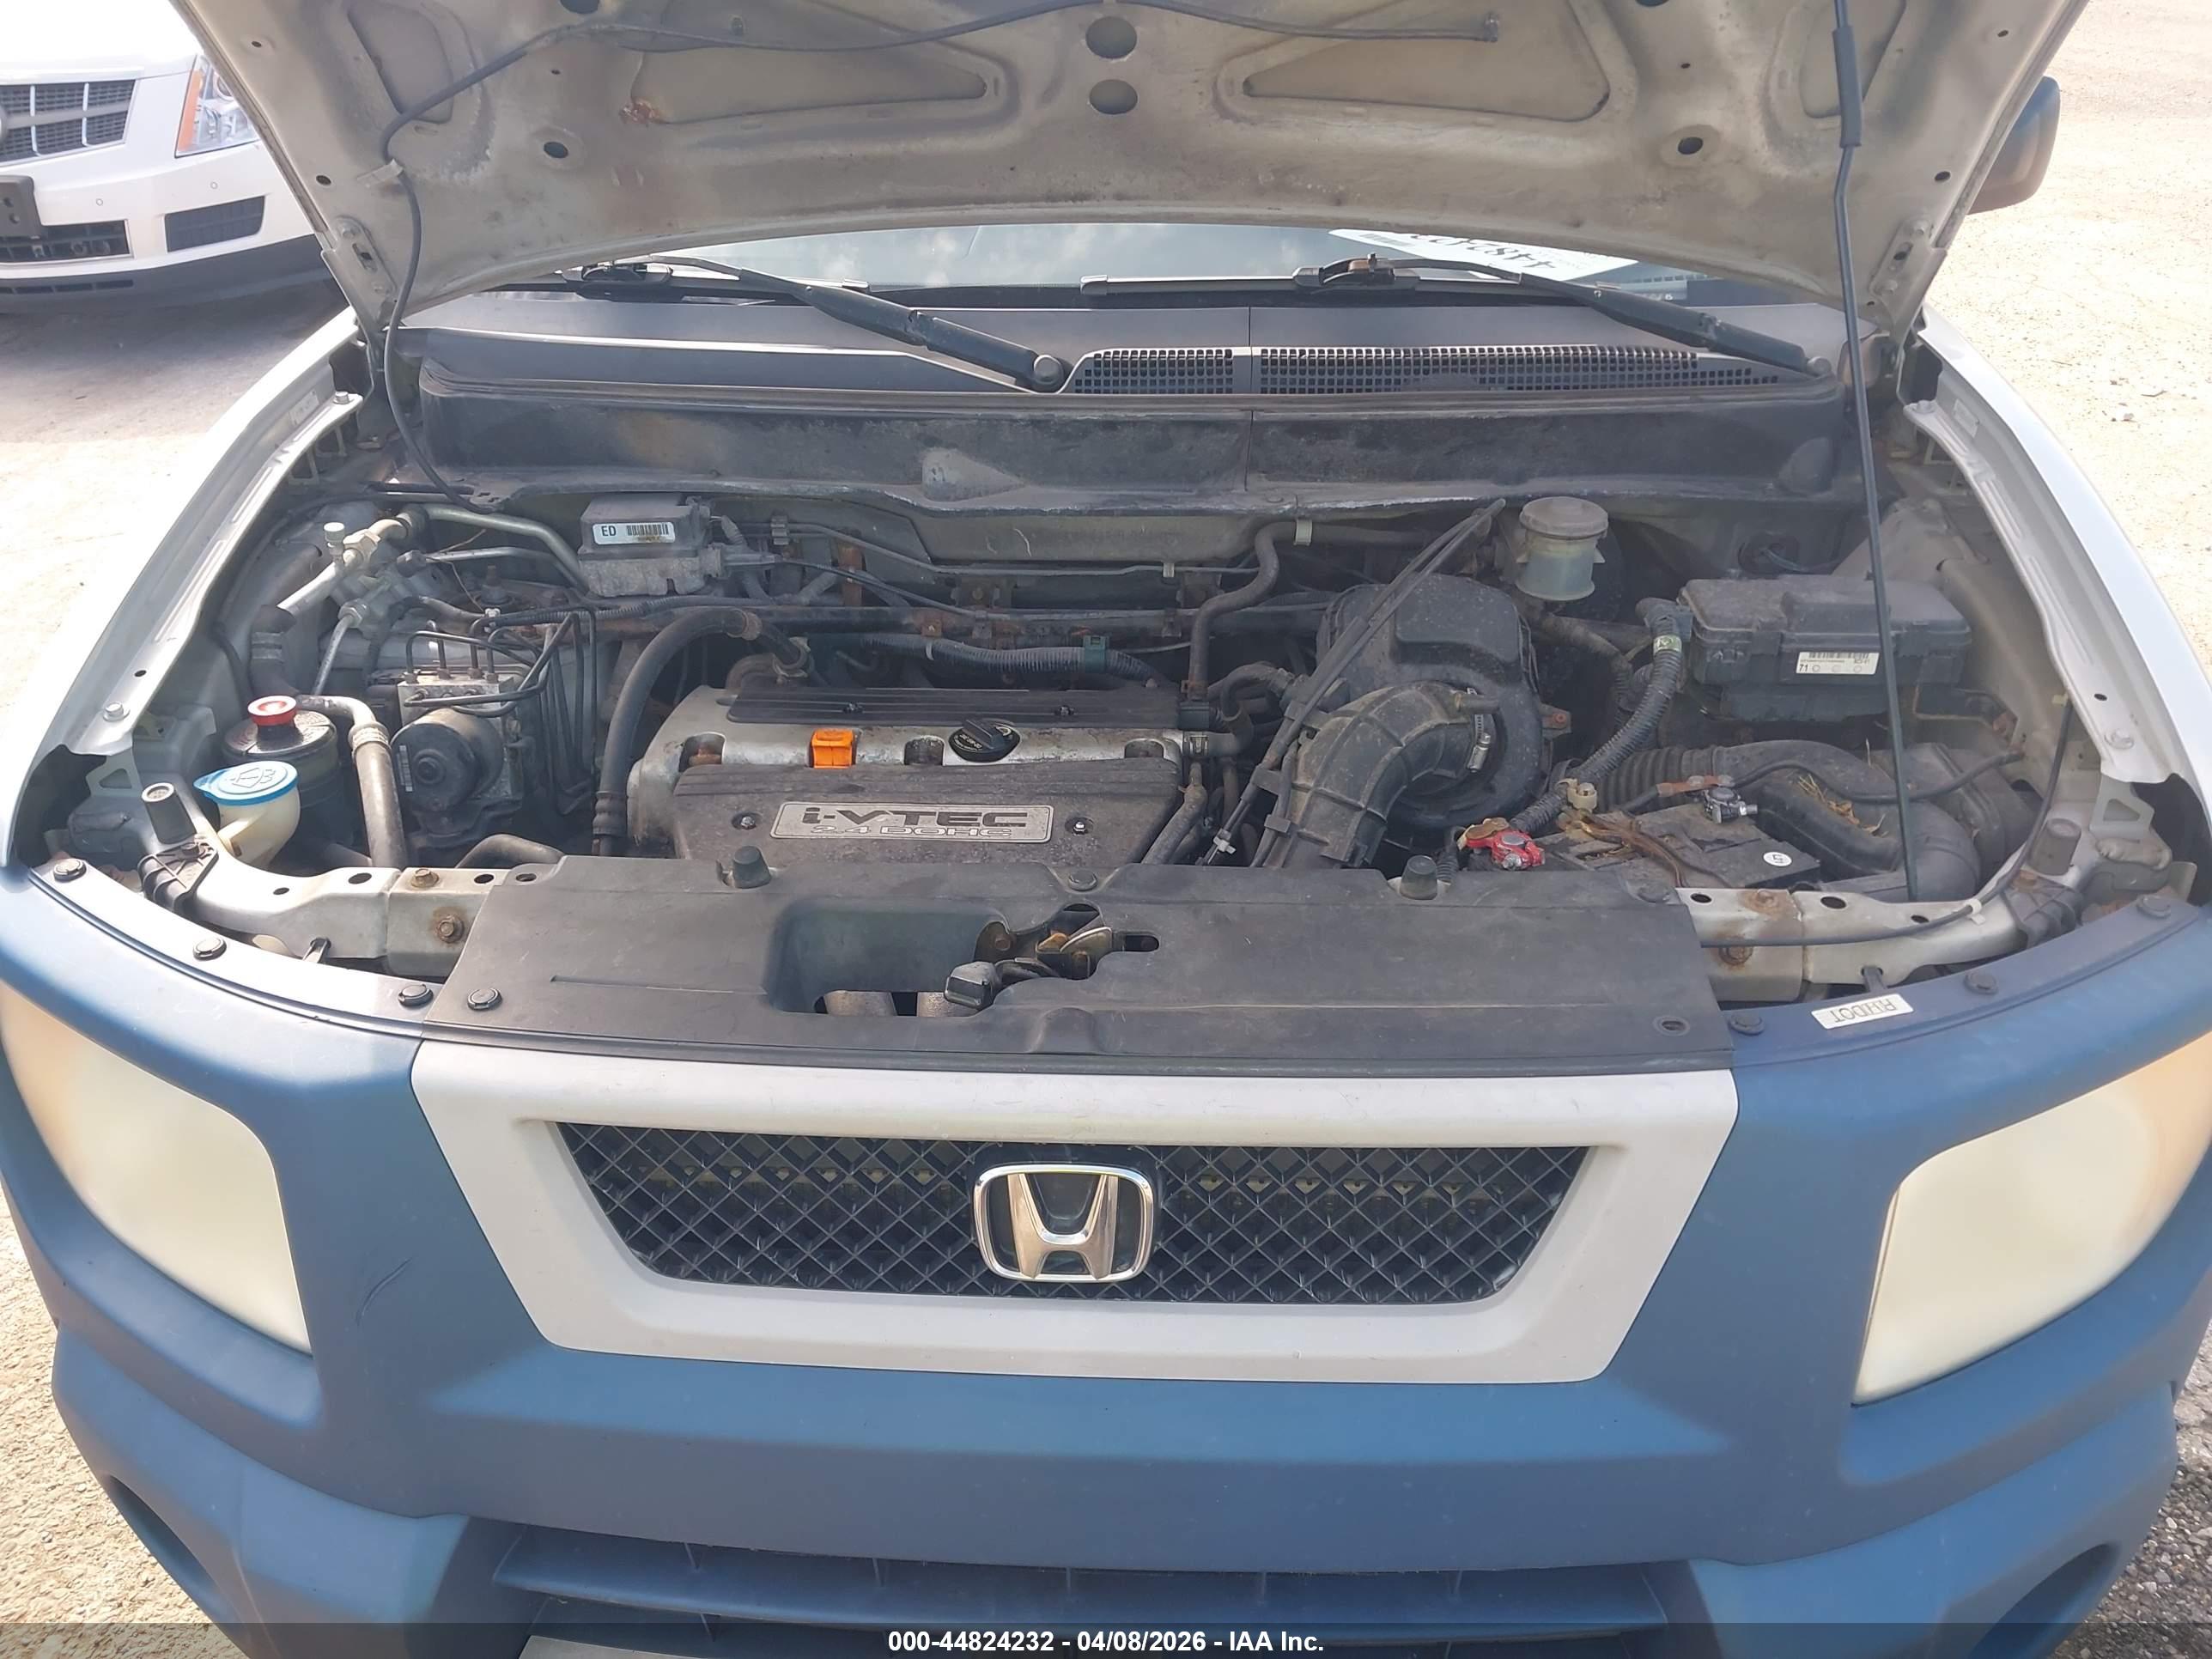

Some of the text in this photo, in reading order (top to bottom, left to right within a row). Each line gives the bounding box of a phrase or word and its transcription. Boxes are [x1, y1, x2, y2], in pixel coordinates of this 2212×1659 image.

[601, 525, 617, 537] ED
[801, 806, 1029, 828] i-VTEC
[810, 824, 1012, 837] 2.4 DOHC
